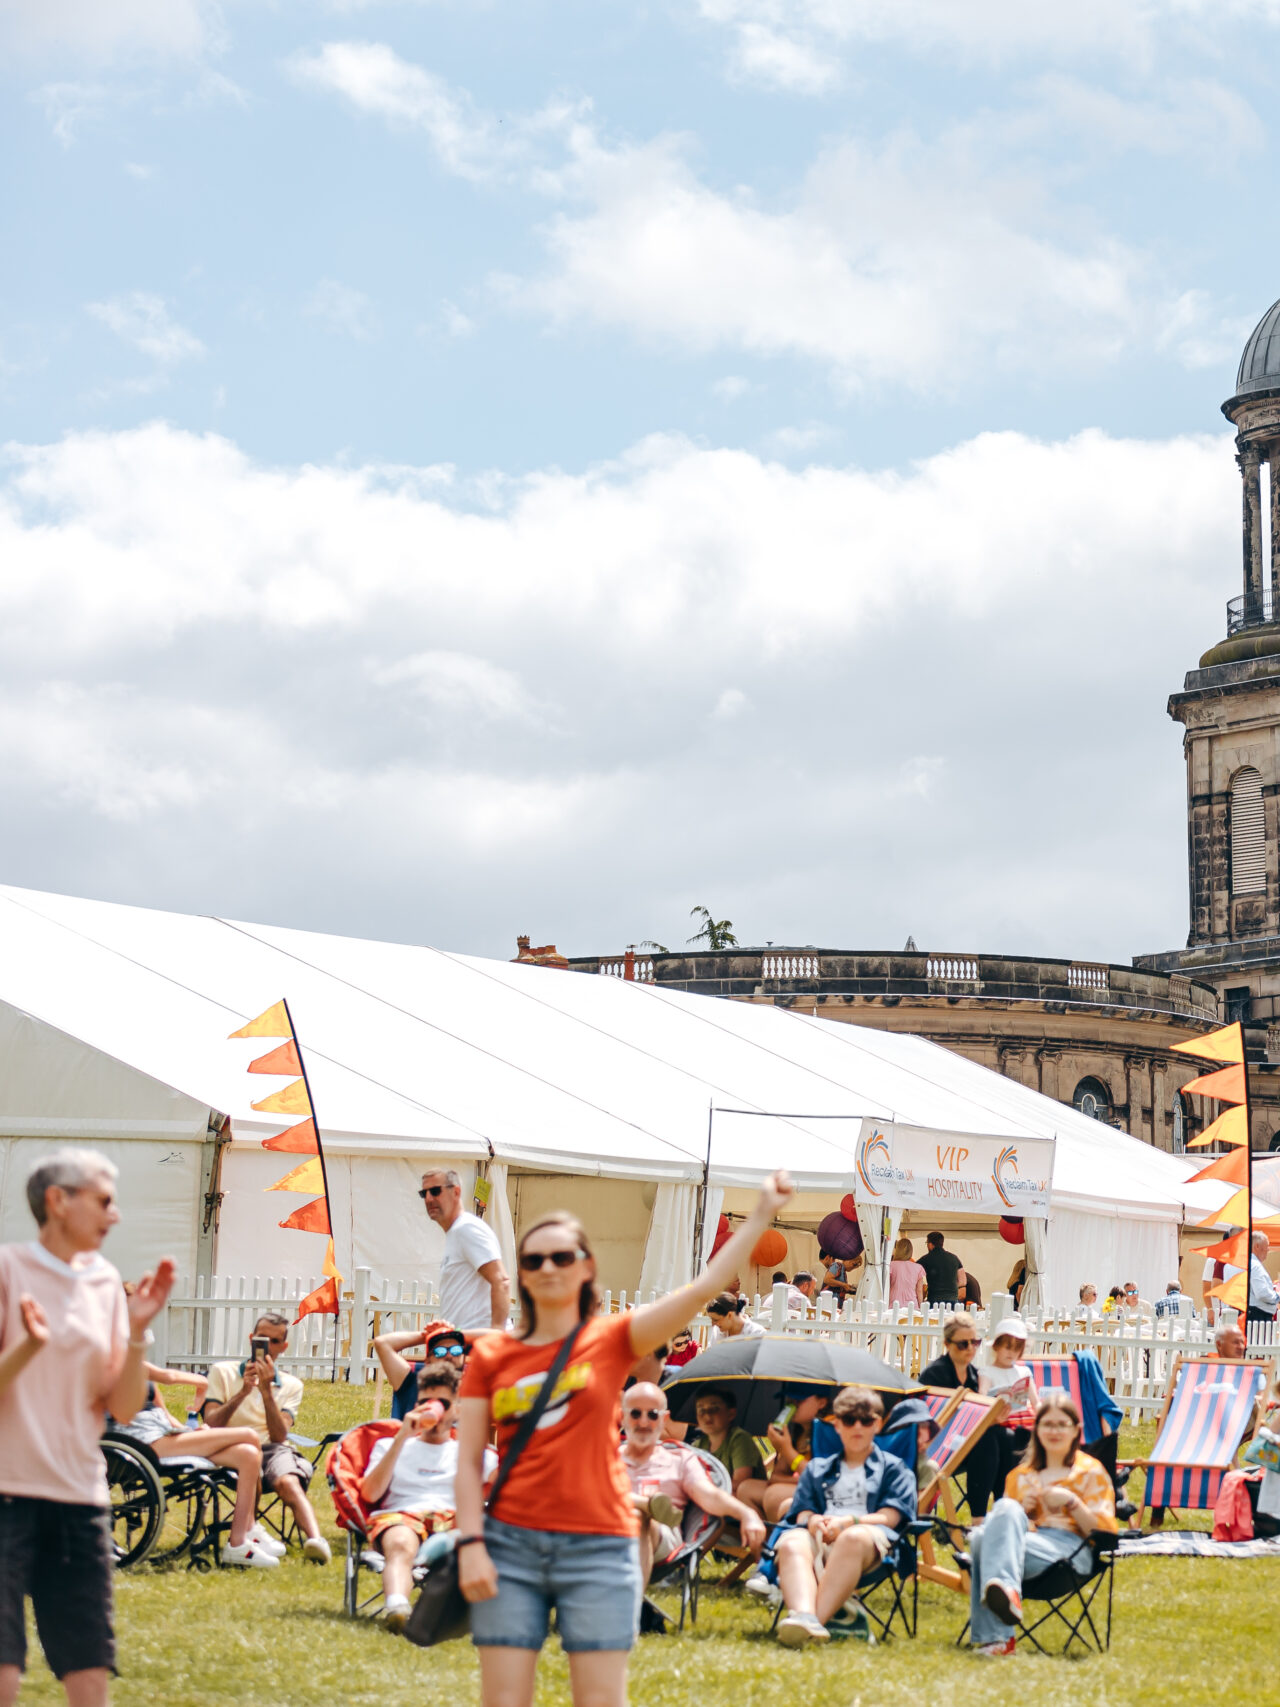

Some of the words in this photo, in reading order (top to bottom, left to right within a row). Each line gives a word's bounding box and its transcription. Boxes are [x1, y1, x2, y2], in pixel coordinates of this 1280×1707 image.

[937, 1145, 969, 1171] VIP
[905, 1169, 915, 1181] UK
[928, 1178, 982, 1200] HOSPITALITY
[1004, 1177, 1027, 1190] Reclaim
[1027, 1179, 1037, 1191] Tax
[1038, 1181, 1047, 1192] UK
